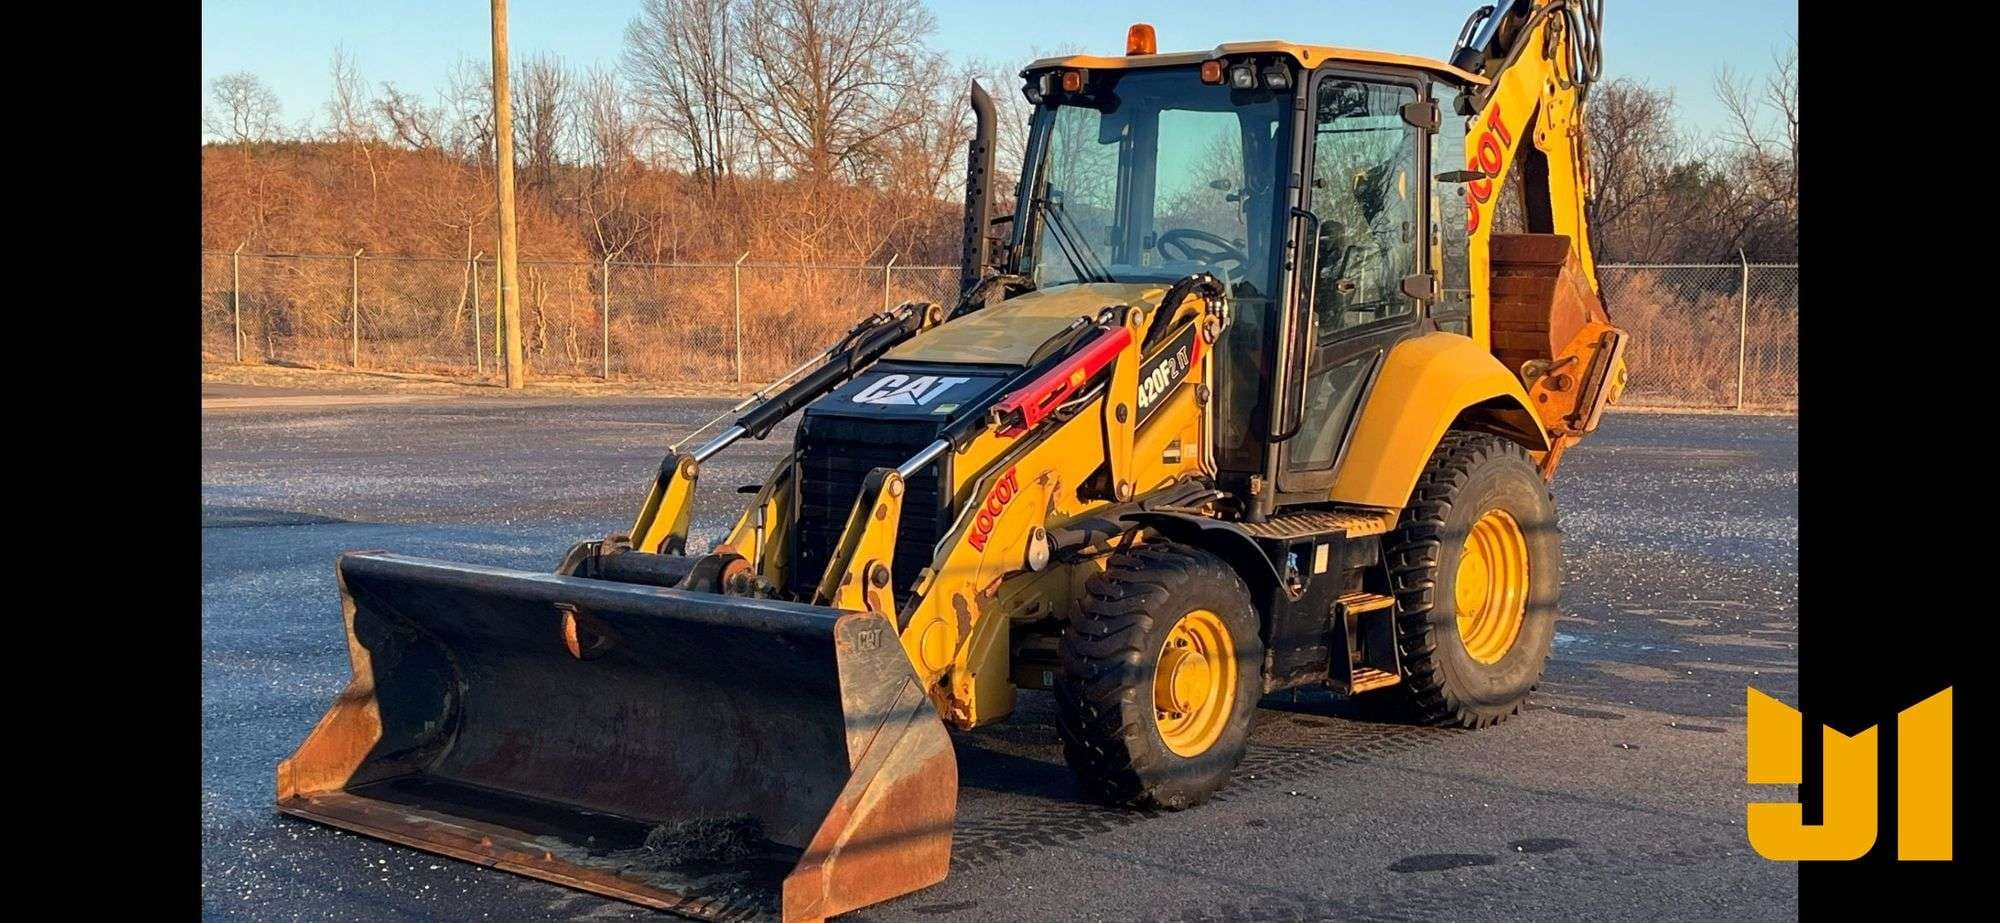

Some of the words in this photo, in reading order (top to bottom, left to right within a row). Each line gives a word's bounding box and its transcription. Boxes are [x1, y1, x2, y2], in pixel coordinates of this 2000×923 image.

[1466, 101, 1511, 236] OCOT
[852, 374, 971, 405] CAT
[968, 465, 1018, 552] KOCOT
[857, 628, 883, 650] CAT
